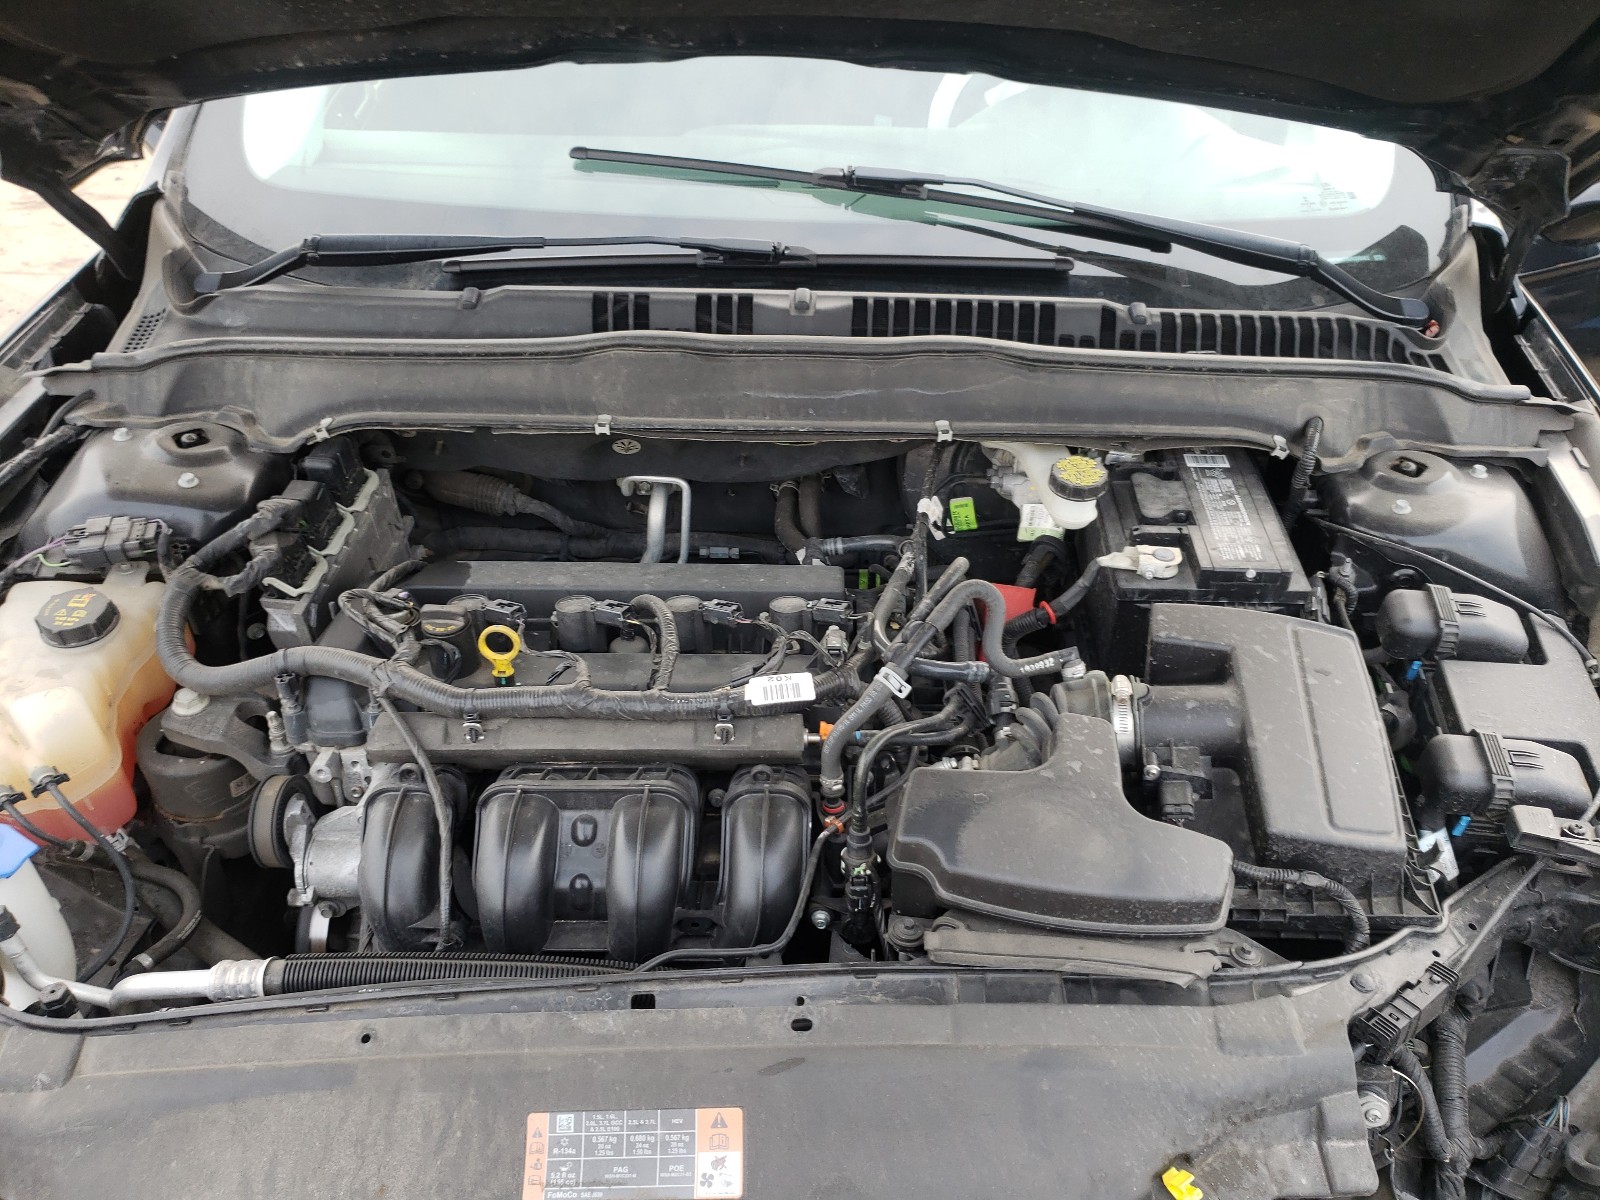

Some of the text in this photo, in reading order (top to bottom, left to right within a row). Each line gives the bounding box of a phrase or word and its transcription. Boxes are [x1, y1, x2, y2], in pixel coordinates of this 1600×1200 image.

[609, 1136, 617, 1144] kg
[647, 1135, 655, 1143] kg
[682, 1134, 690, 1142] kg
[547, 1190, 578, 1199] FoMoCo
